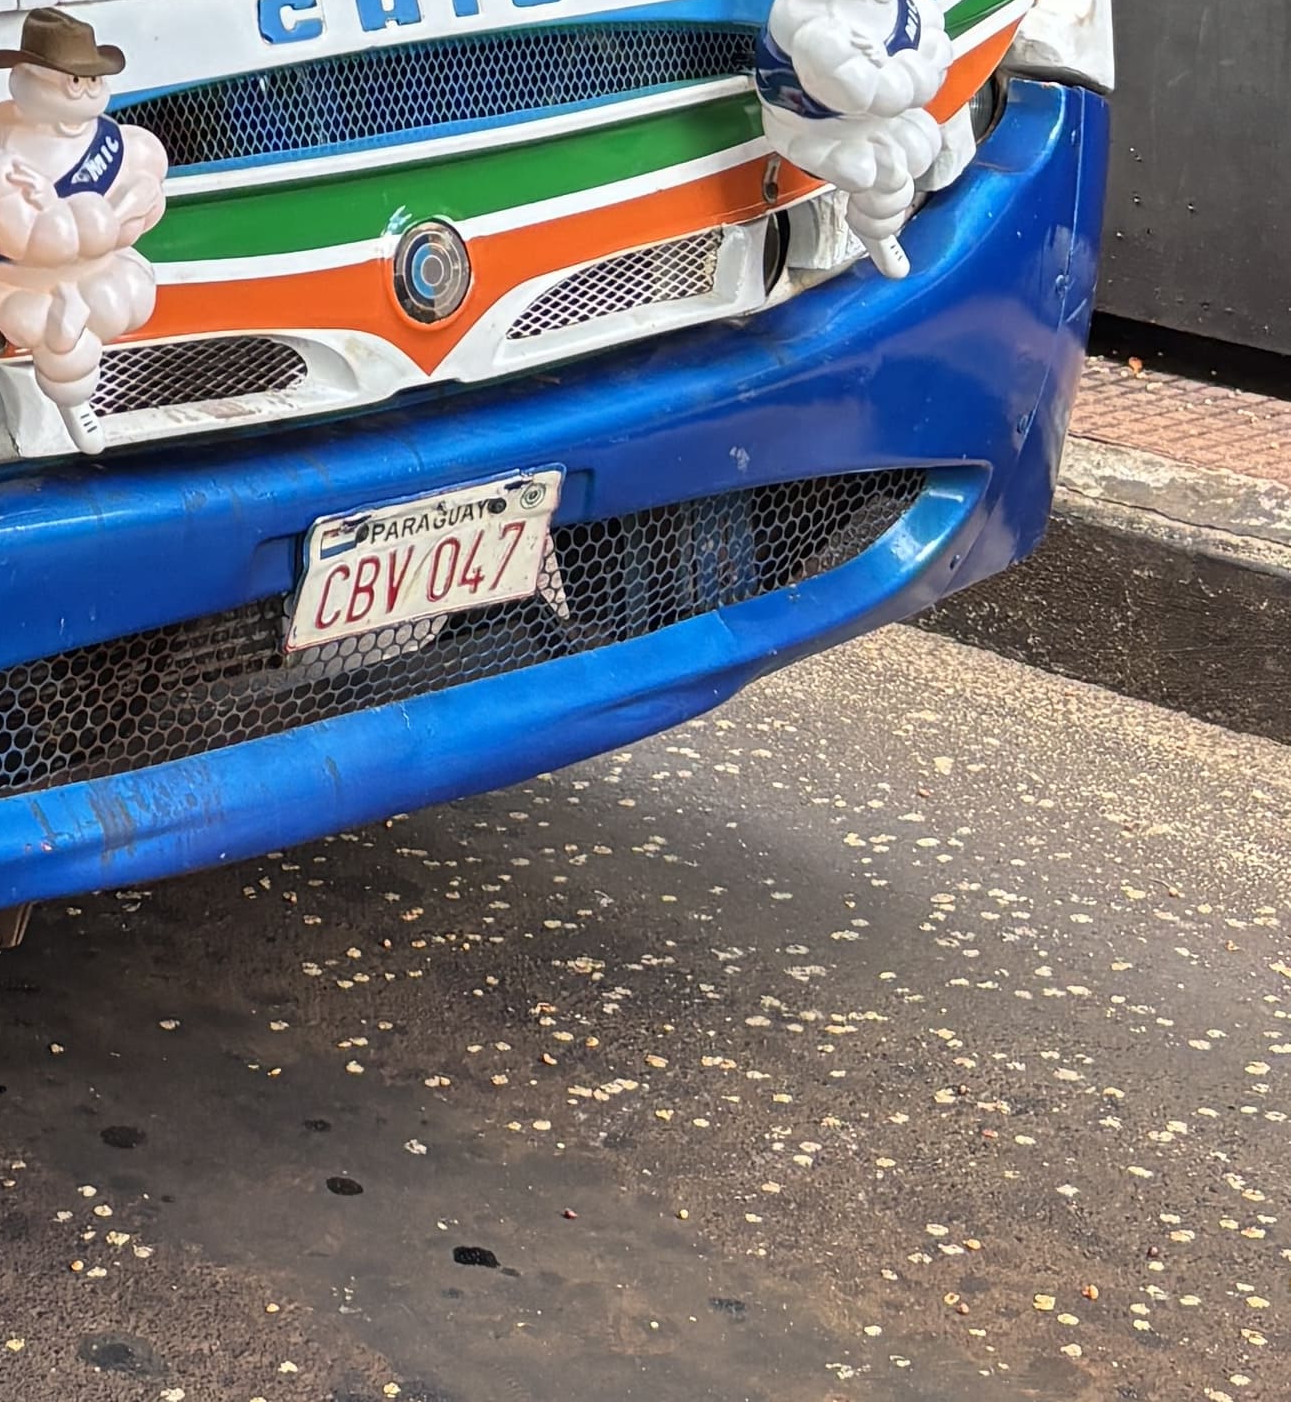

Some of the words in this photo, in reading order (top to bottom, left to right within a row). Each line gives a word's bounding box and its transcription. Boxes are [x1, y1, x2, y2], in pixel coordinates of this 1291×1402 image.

[370, 498, 491, 545] PARAGUAY
[316, 546, 415, 629] CBV
[426, 521, 526, 602] 047
